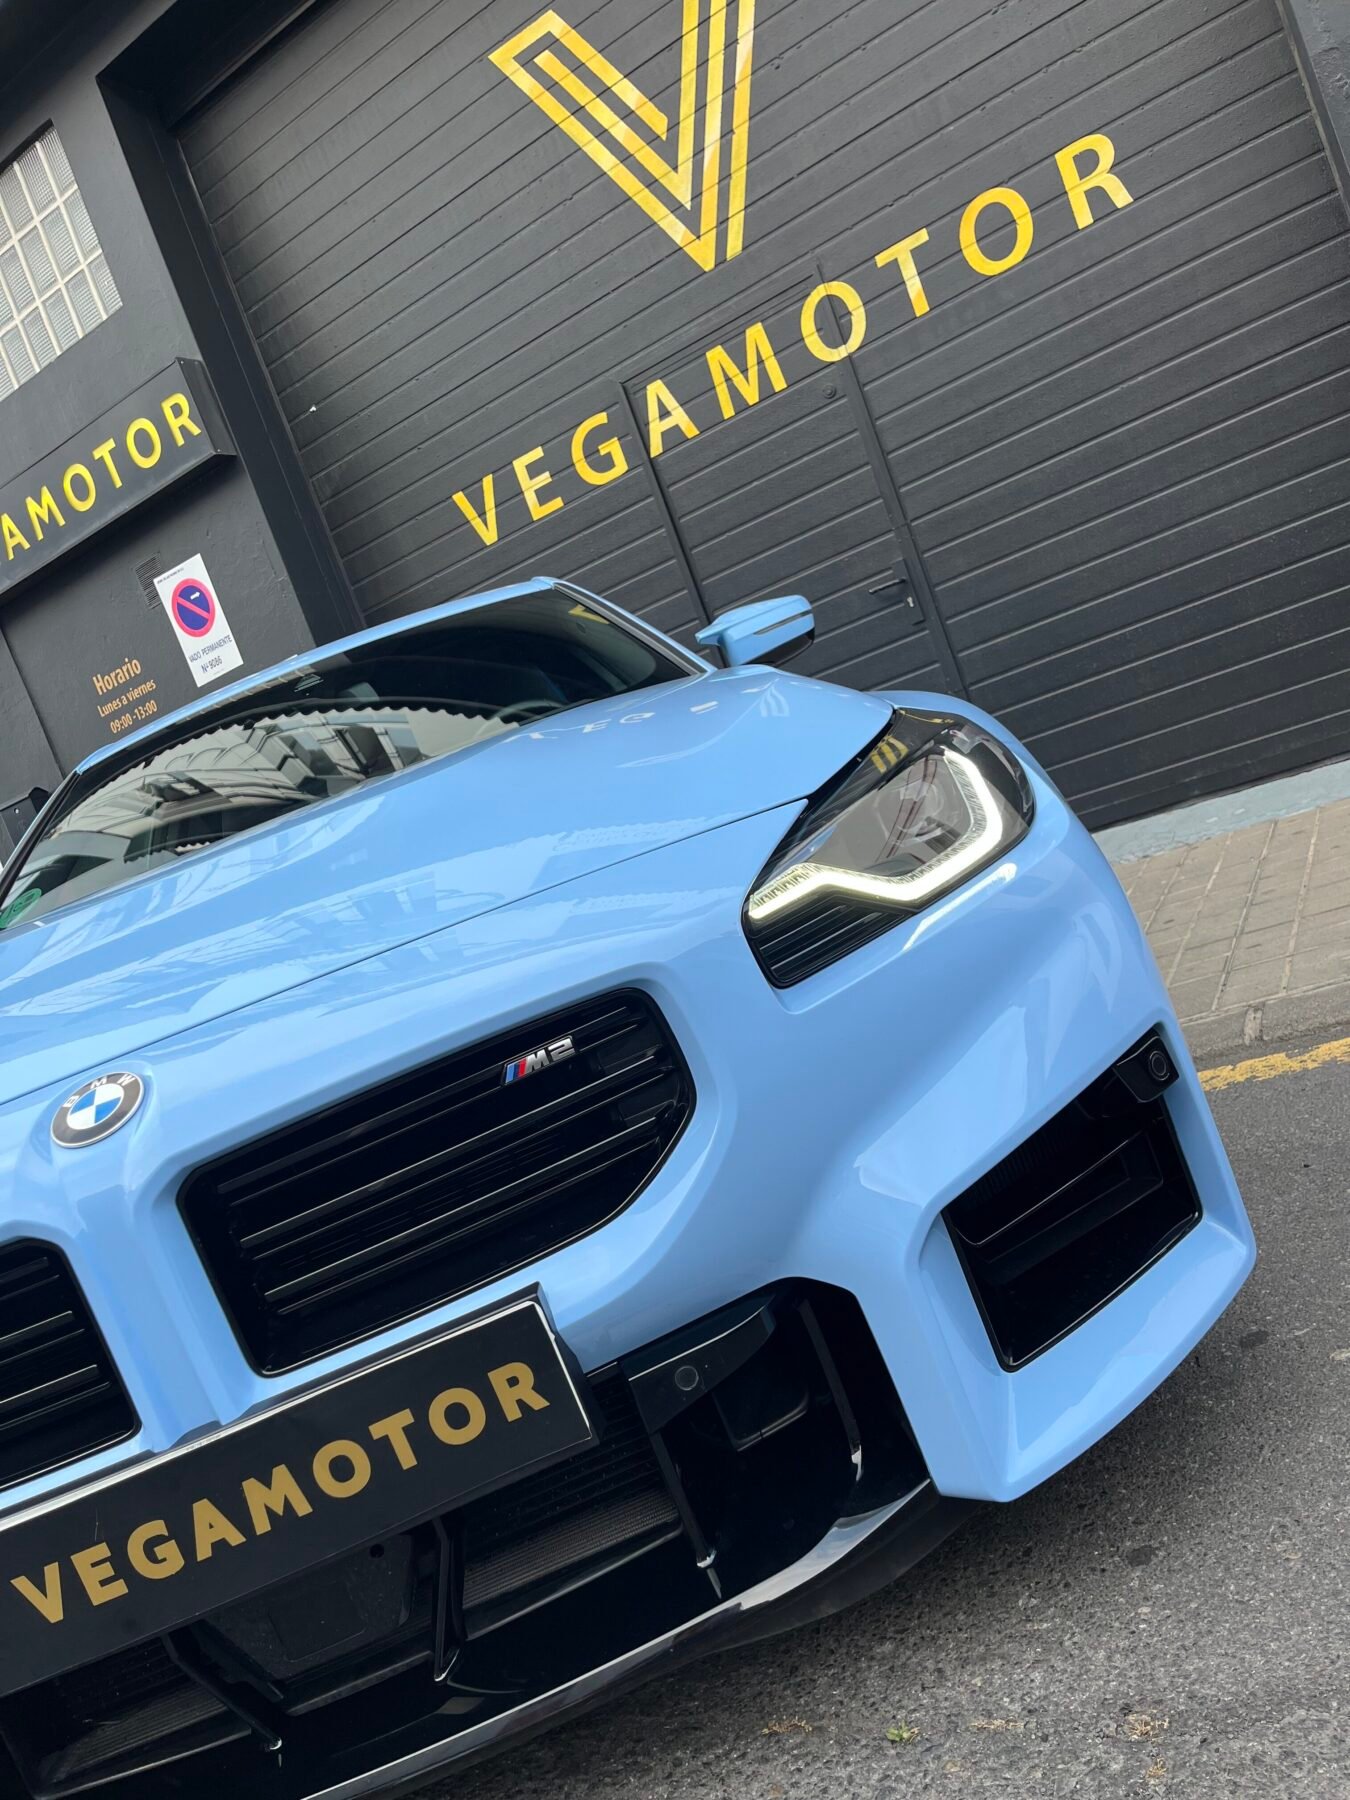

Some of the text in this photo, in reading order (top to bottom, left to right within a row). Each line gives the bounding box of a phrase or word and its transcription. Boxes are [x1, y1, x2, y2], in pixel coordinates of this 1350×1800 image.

[452, 133, 1133, 546] VEGAMOTOR
[201, 634, 233, 656] PERMANENTE
[92, 657, 142, 696] Horario
[97, 679, 157, 717] Lunes a viernes
[110, 713, 133, 734] 09:00
[525, 1037, 576, 1075] M2
[62, 1073, 136, 1108] BMW
[10, 1361, 550, 1624] VEGAMOTOR
